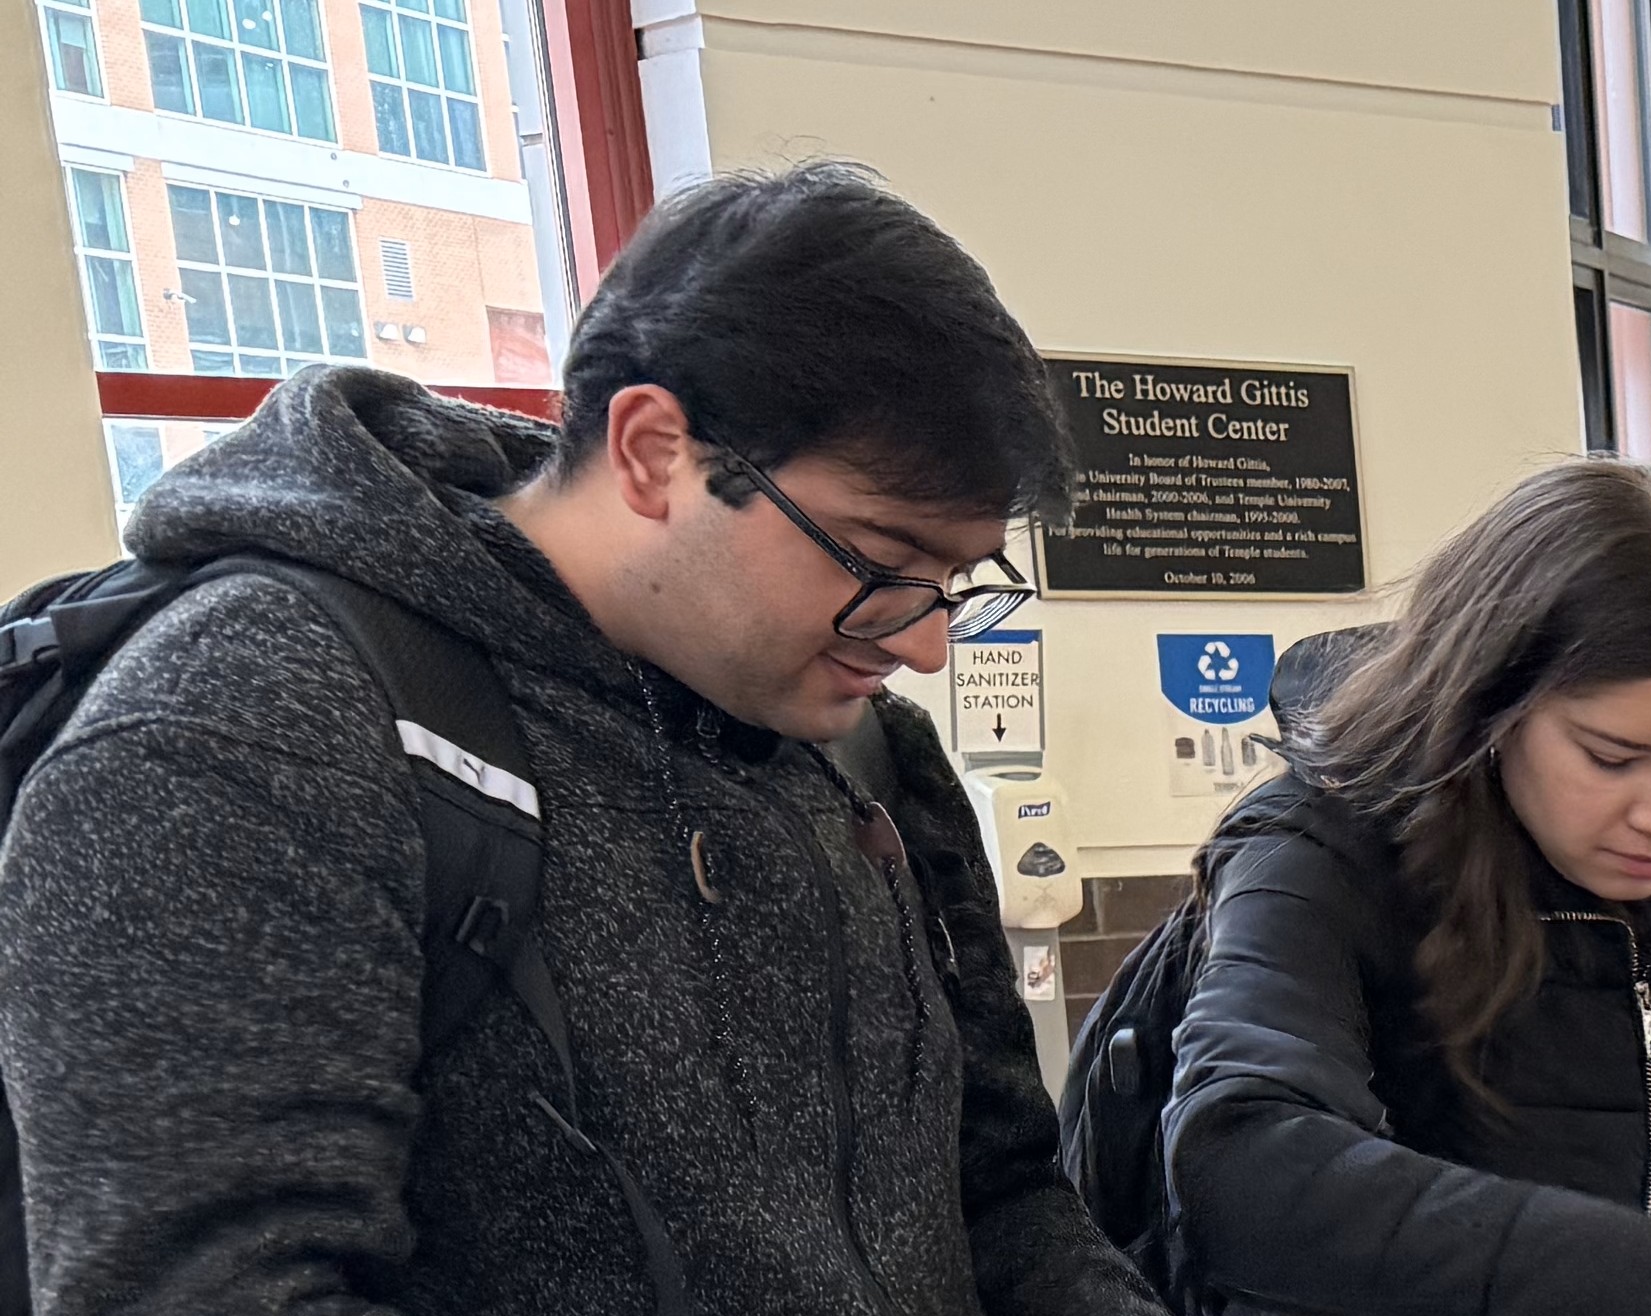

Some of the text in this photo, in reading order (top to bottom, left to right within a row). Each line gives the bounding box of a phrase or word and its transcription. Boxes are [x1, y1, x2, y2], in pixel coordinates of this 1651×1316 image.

[1073, 372, 1309, 408] The Howard Gittis
[1102, 409, 1289, 442] Student Center
[1088, 470, 1146, 487] University
[1149, 472, 1182, 486] Board
[1185, 472, 1198, 486] of
[1199, 474, 1244, 488] Trustees
[1093, 488, 1149, 504] chairman,
[1238, 493, 1275, 508] Temple
[1277, 494, 1332, 511] University
[1145, 508, 1185, 523] System
[1126, 526, 1188, 539] educational
[1190, 528, 1261, 542] opportunities
[1264, 528, 1284, 541] and
[1144, 545, 1206, 559] generations
[1208, 546, 1220, 558] of
[1164, 571, 1207, 585] October
[972, 650, 1022, 666] HAND
[956, 672, 1040, 688] SANITIZER
[963, 694, 1034, 710] STATION
[1188, 696, 1256, 714] RECYCLING
